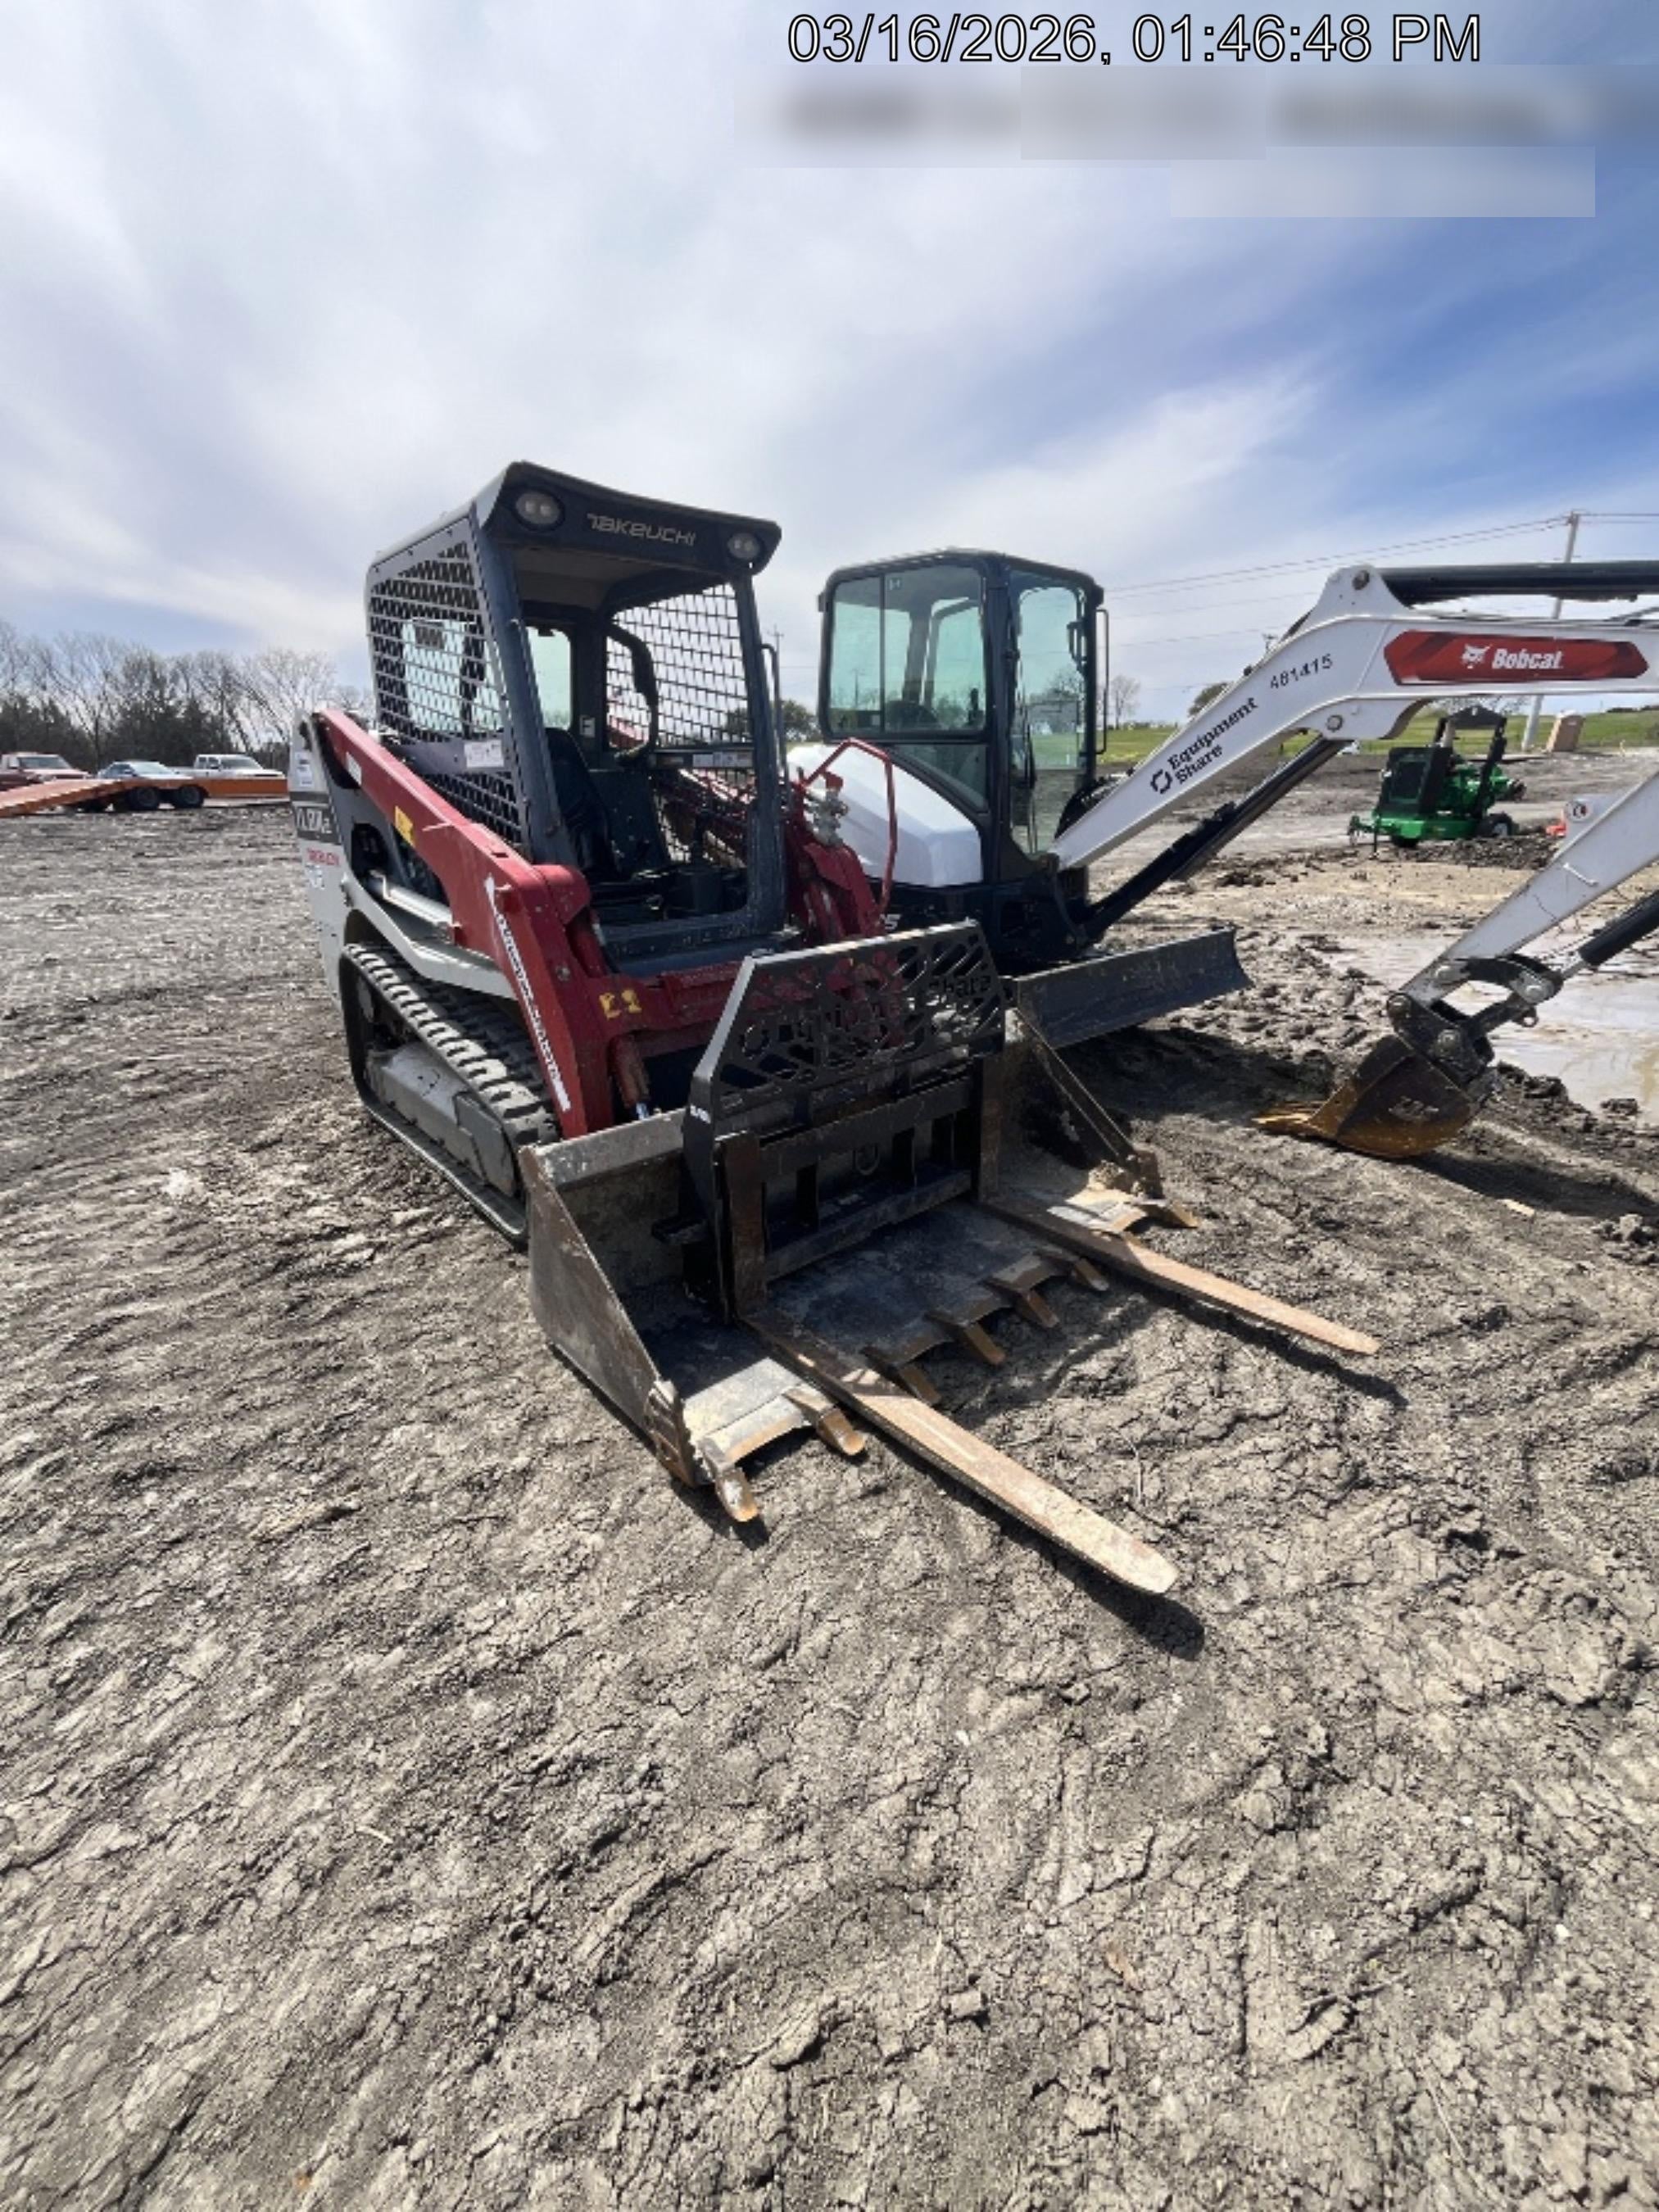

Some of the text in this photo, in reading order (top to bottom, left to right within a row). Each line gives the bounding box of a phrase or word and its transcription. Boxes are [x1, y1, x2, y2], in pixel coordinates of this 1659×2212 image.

[1270, 653, 1334, 690] 481415
[1492, 648, 1562, 669] Bobcat
[1167, 697, 1259, 770] Equipment
[1174, 745, 1223, 785] Share
